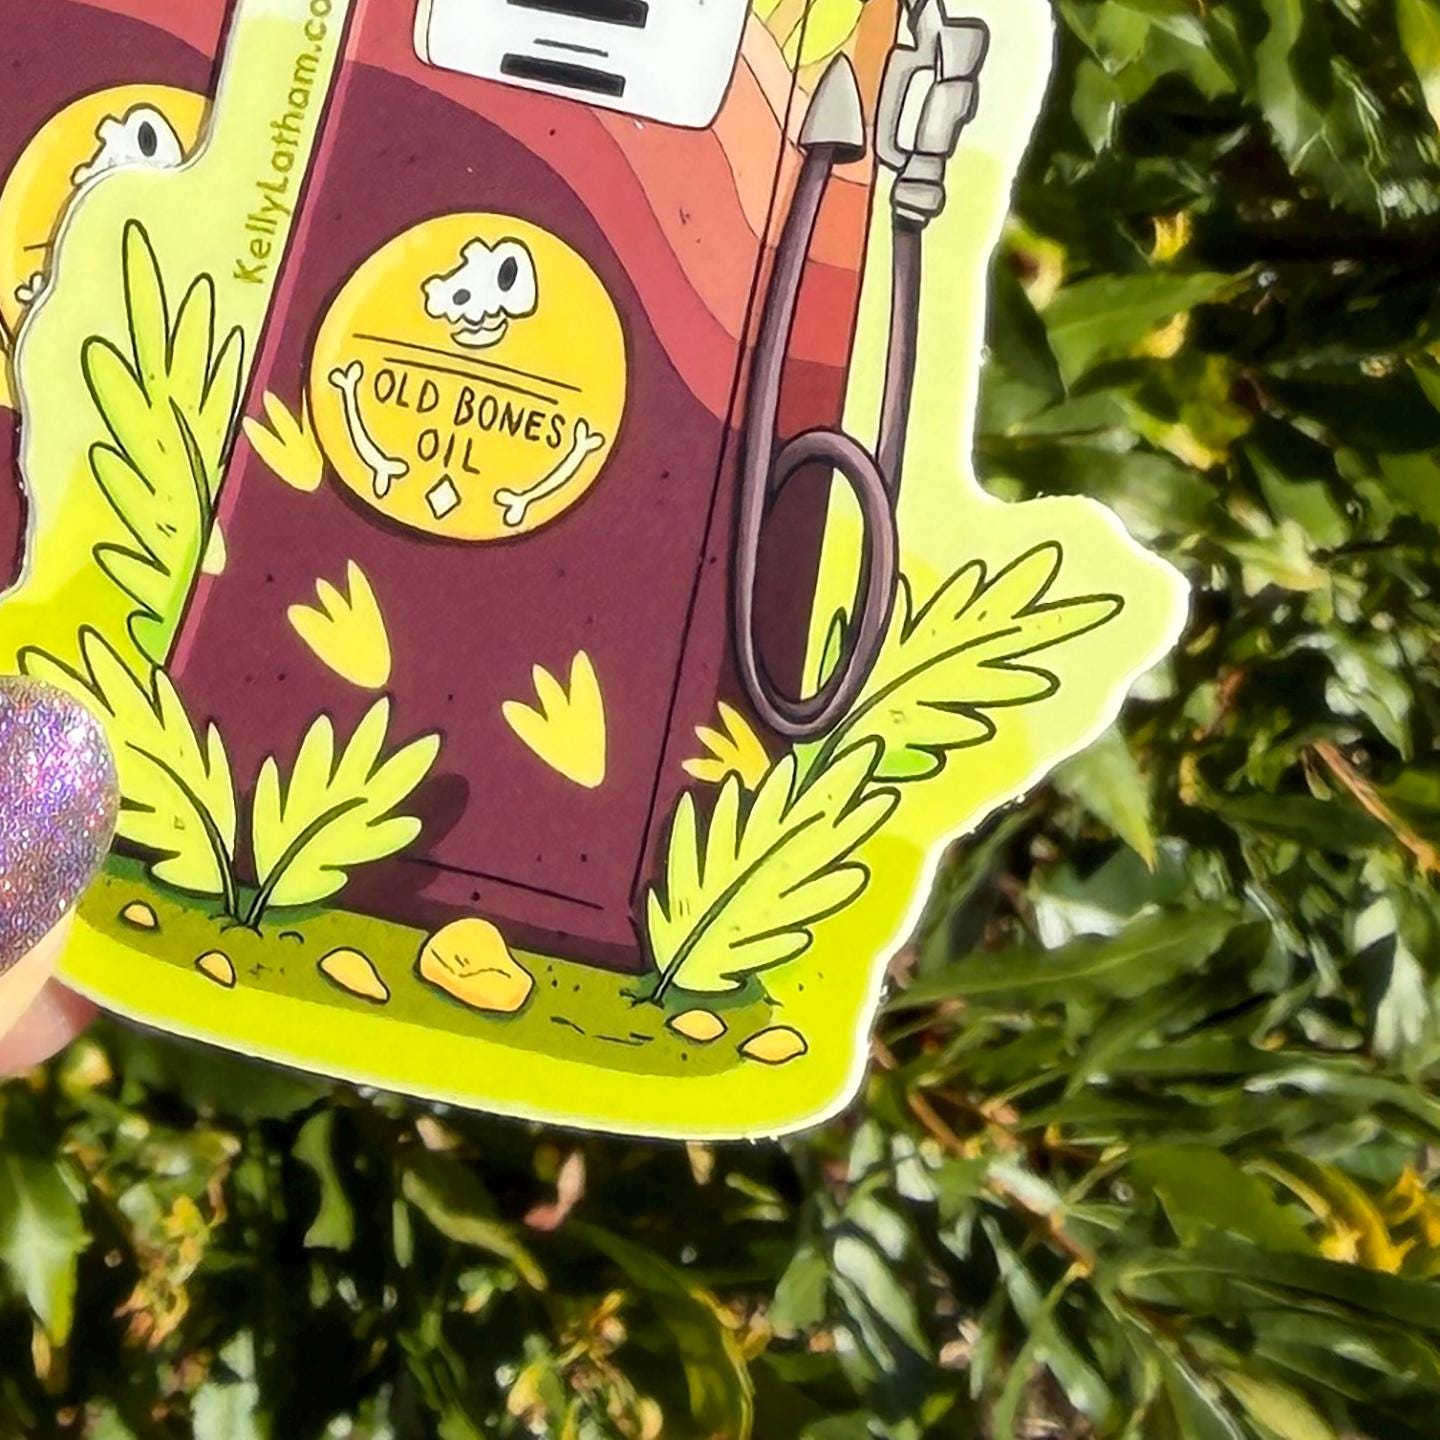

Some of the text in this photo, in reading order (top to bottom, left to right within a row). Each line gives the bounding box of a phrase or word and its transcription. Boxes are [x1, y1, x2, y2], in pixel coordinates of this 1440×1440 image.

[374, 368, 565, 448] OLD BONES
[417, 429, 480, 474] OIL
